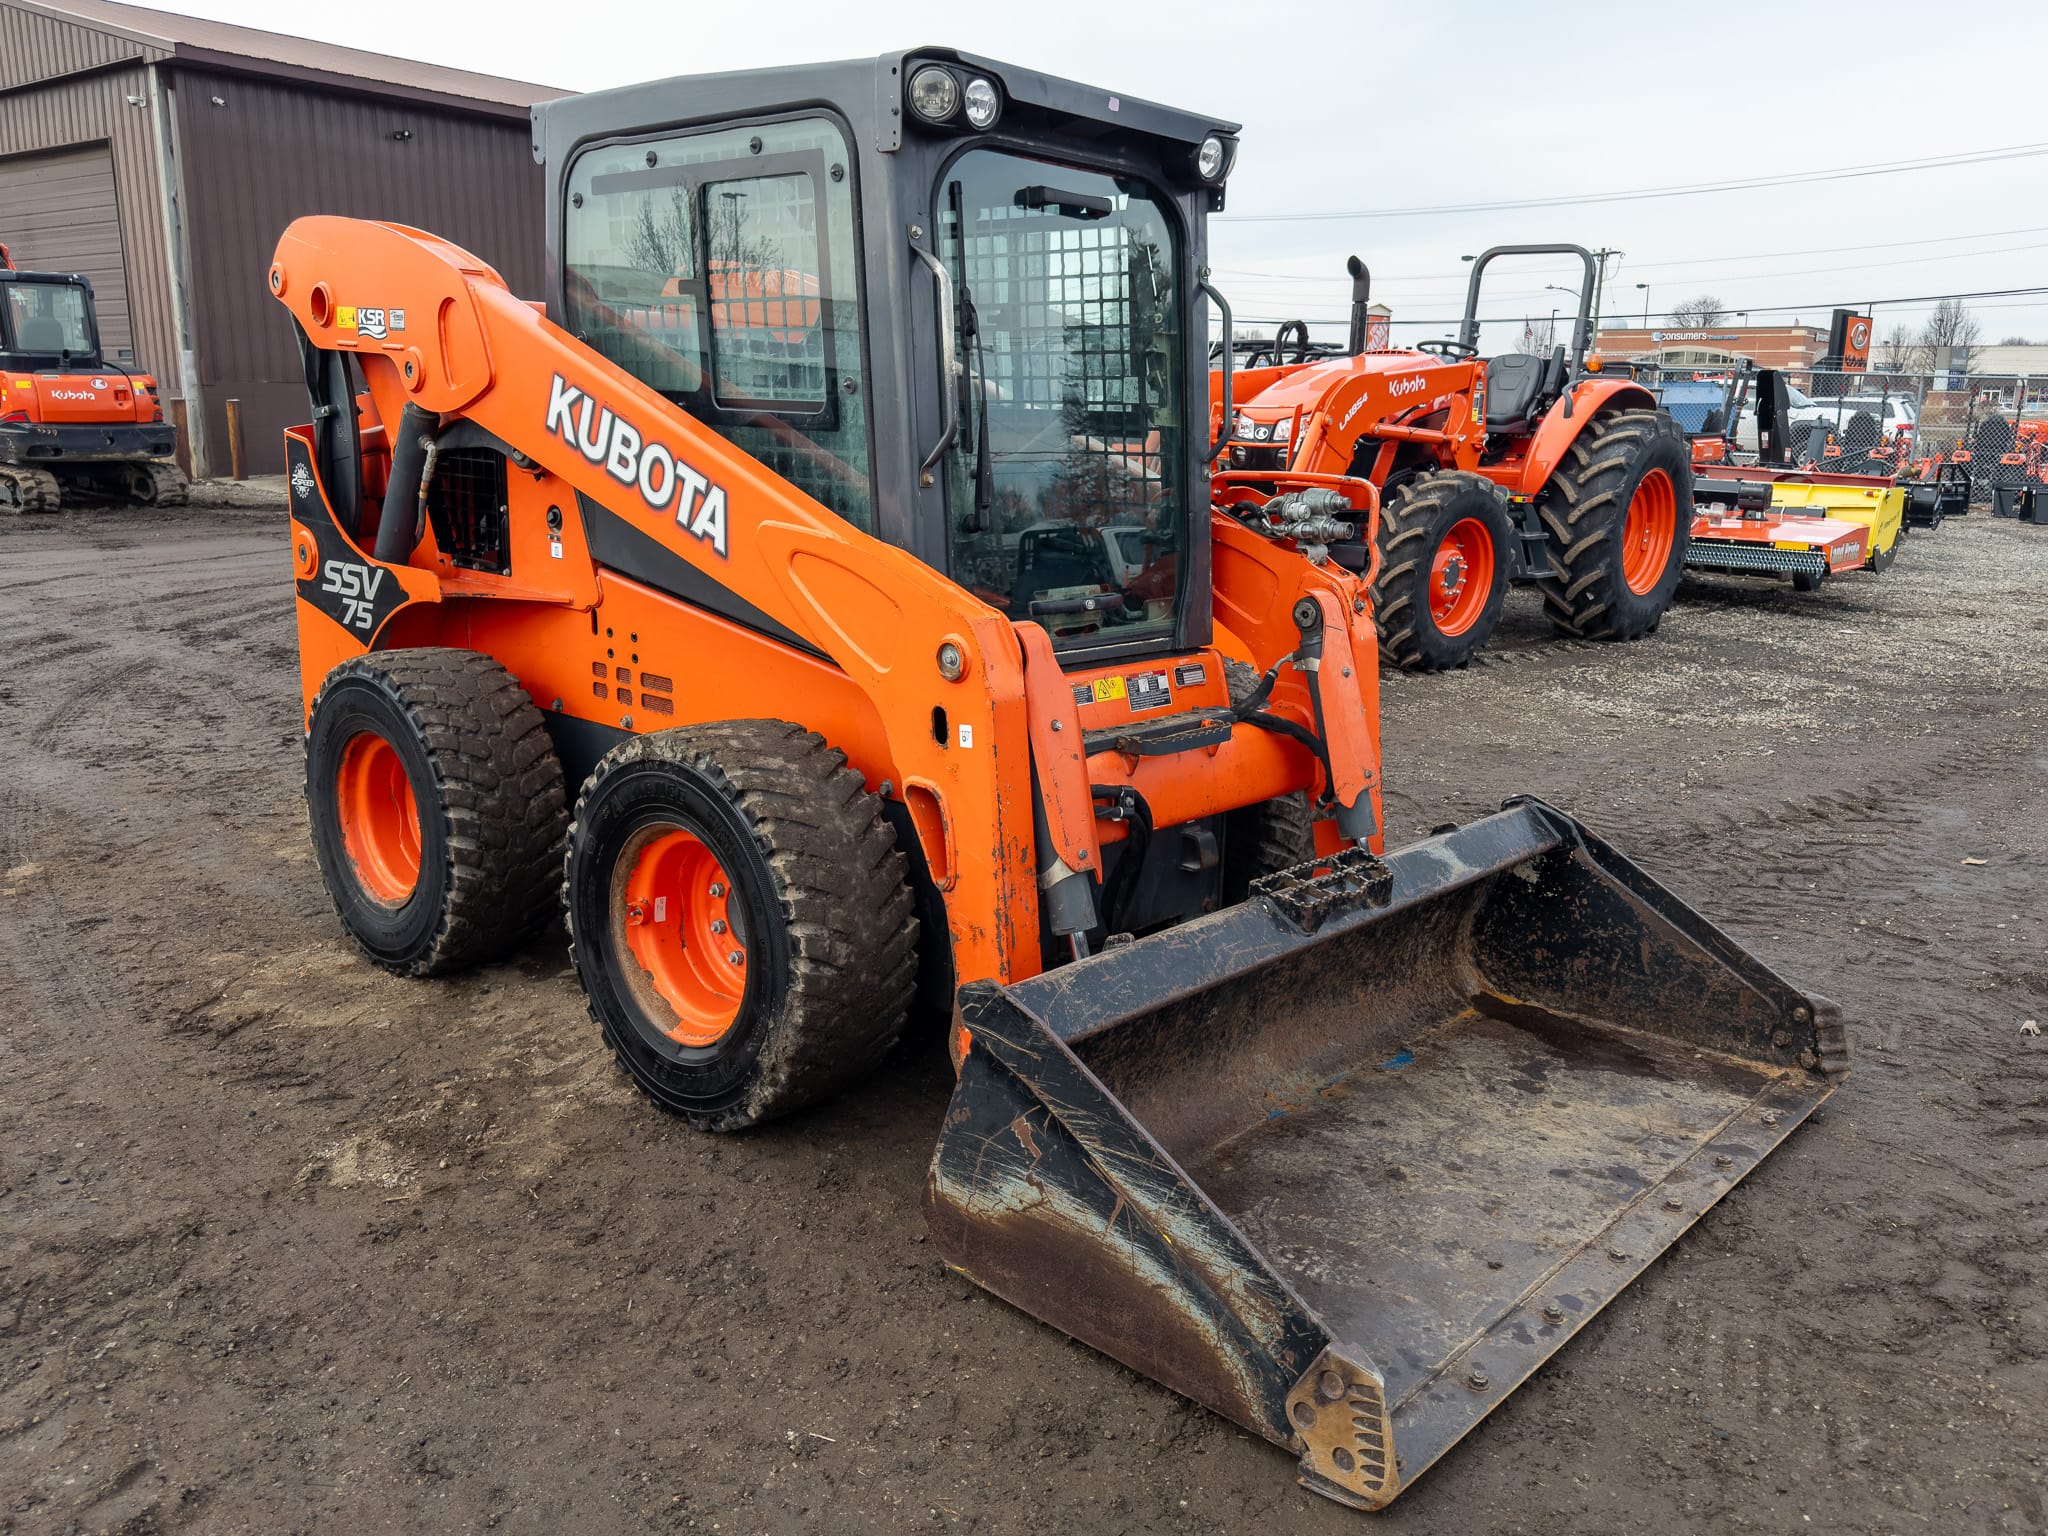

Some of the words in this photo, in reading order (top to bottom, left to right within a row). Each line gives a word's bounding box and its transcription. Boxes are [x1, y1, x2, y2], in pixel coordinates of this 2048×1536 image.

[358, 308, 385, 326] KSR
[1661, 331, 1707, 341] consumers
[51, 390, 95, 400] Kubota
[1389, 375, 1426, 397] Kubota
[545, 371, 728, 559] KUBOTA
[291, 473, 298, 485] 2
[297, 478, 314, 487] SPEED
[321, 559, 384, 601] SSV
[342, 597, 374, 630] 75
